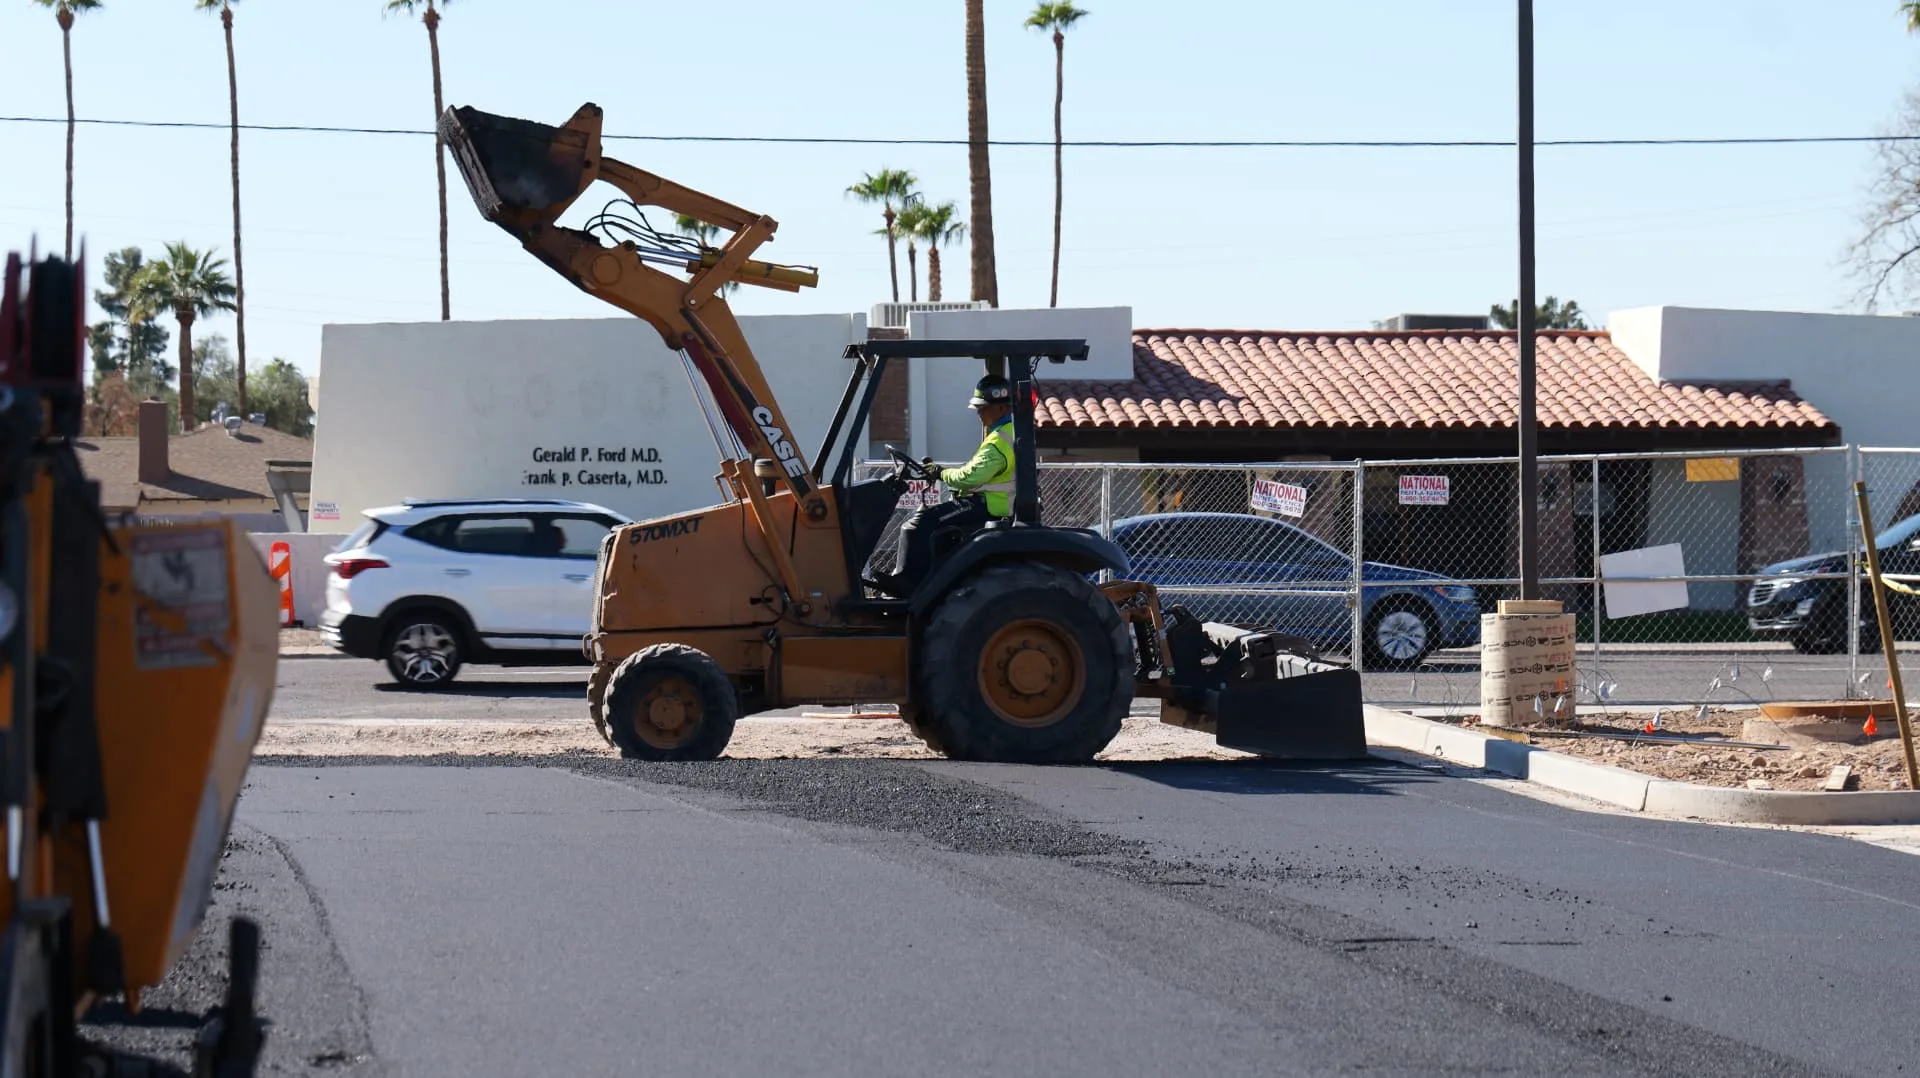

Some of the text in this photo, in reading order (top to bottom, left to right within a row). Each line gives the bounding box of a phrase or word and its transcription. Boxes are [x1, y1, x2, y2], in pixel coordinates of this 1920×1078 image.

[752, 405, 808, 478] CASE
[532, 446, 662, 463] Gerald P. Ford M.D.
[577, 470, 632, 488] Caserta,
[636, 470, 668, 485] M.D.
[1400, 476, 1447, 490] NATIONAL
[1254, 480, 1305, 503] NATIONAL
[629, 516, 704, 545] 570MXT
